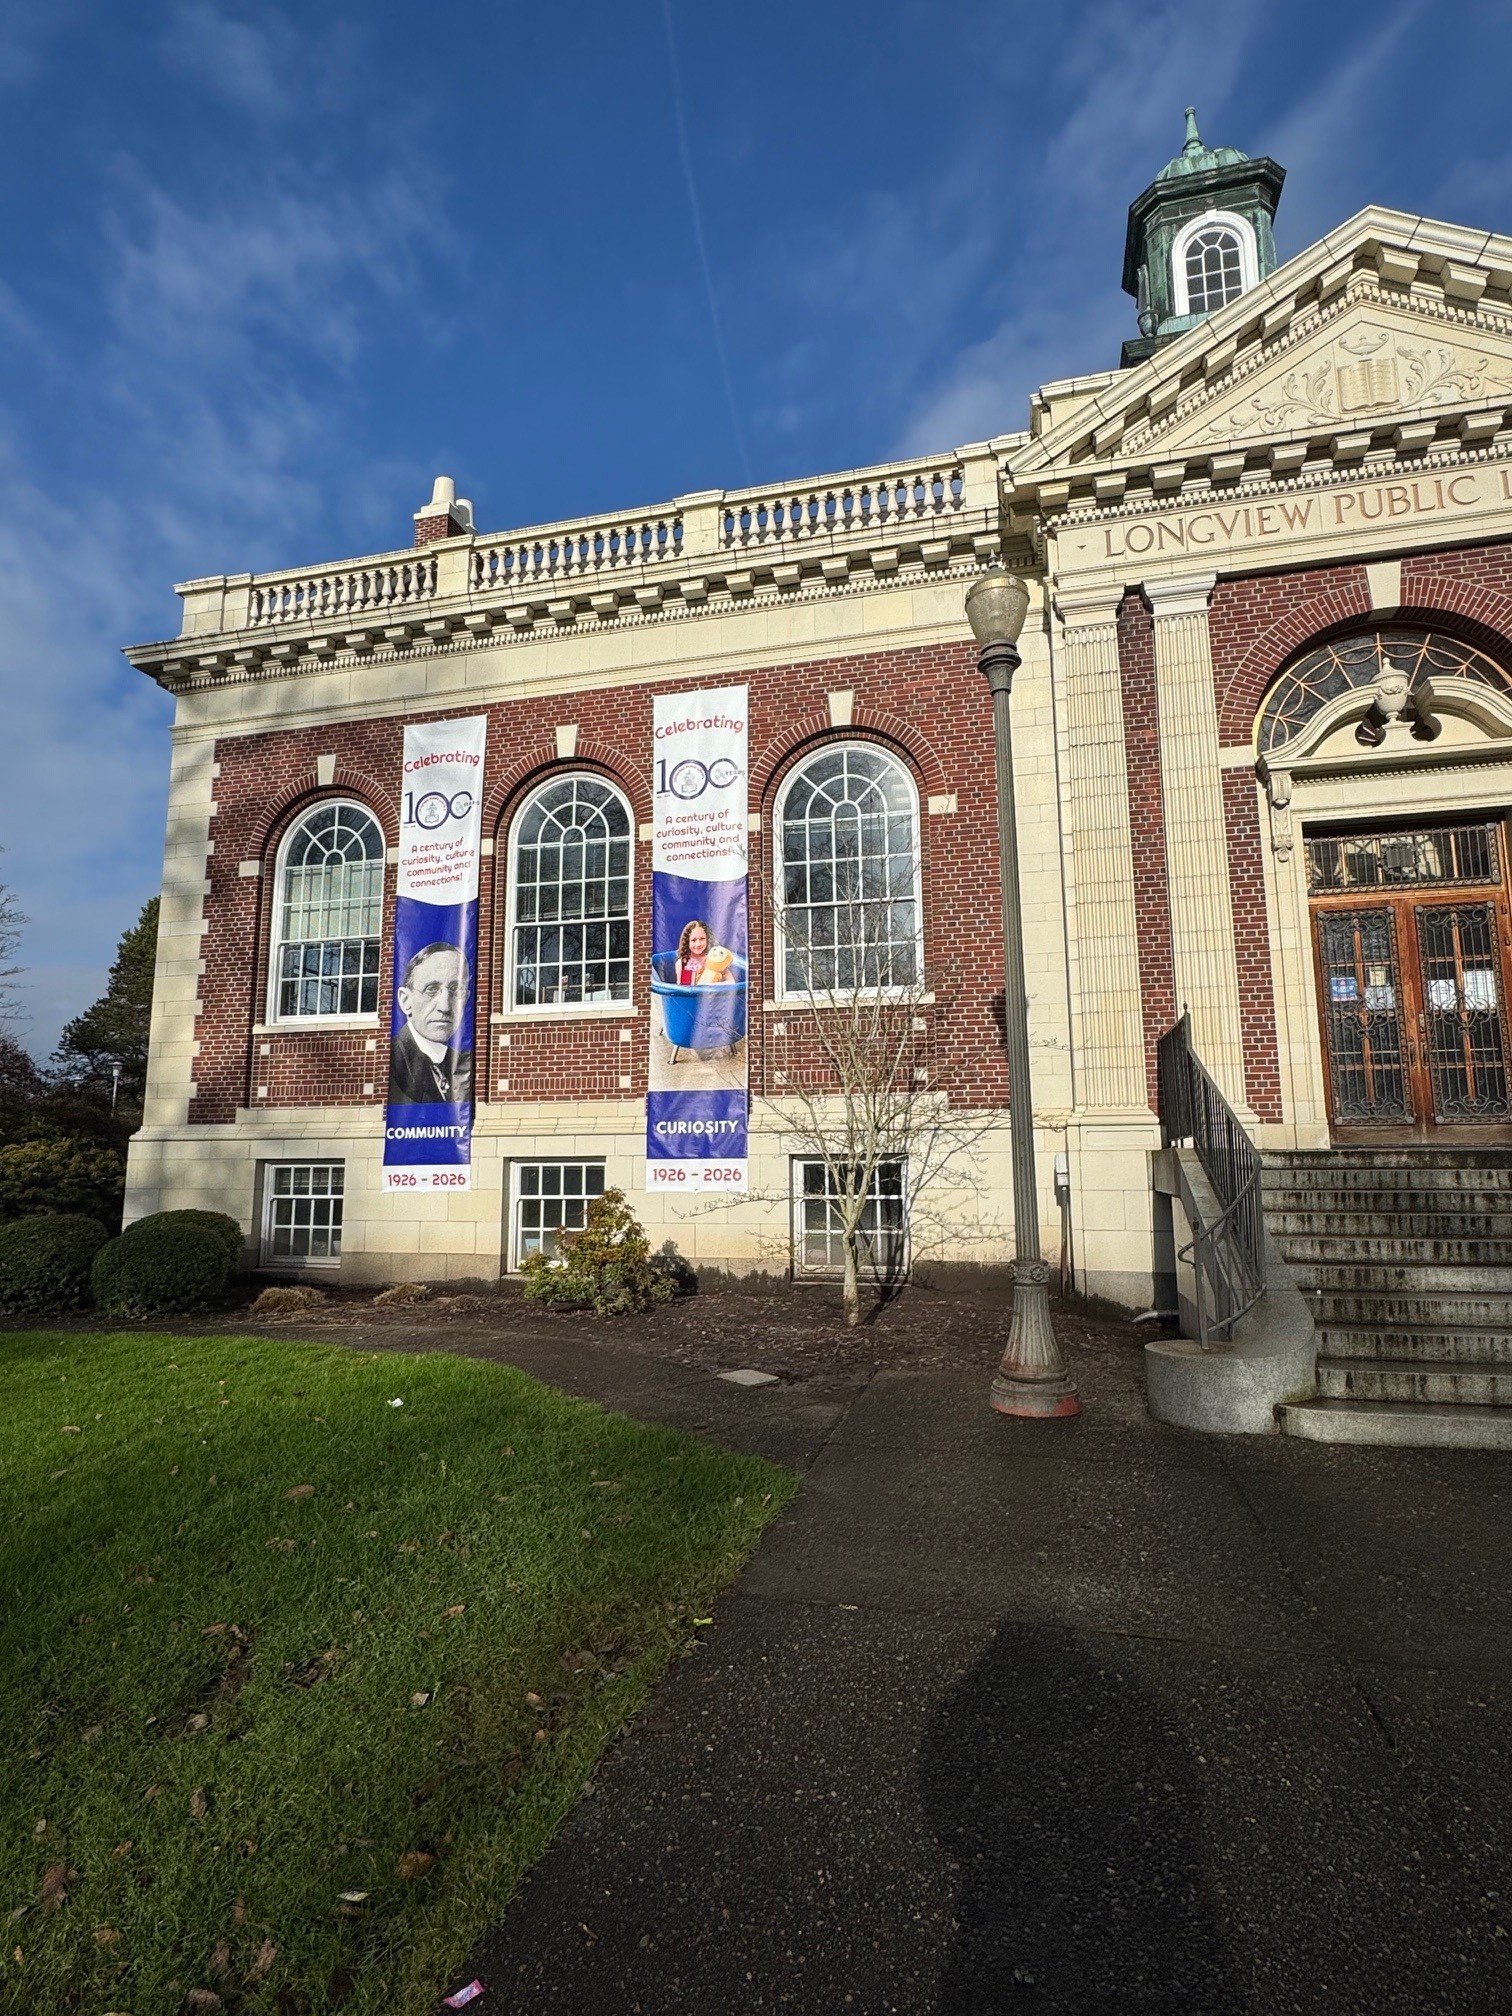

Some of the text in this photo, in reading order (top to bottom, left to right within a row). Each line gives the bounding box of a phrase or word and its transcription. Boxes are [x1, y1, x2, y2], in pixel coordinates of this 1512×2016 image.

[1104, 499, 1313, 559] LONGVIEW
[1334, 475, 1481, 524] PUBLIC
[655, 715, 744, 739] Celebrating
[404, 750, 480, 773] Celebrating
[665, 809, 729, 825] A century of
[656, 822, 743, 838] curiosity, culture
[412, 837, 464, 854] A century of
[661, 834, 740, 850] community and
[402, 854, 443, 866] curiosity,
[666, 847, 731, 862] connections!
[407, 861, 471, 878] community and
[410, 874, 462, 889] connections!
[386, 1125, 467, 1139] COMMUNITY
[656, 1120, 739, 1134] CURIOSITY
[388, 1174, 417, 1186] 1926
[432, 1173, 466, 1186] 2026
[653, 1168, 686, 1181] 1926
[703, 1168, 742, 1181] 2026
